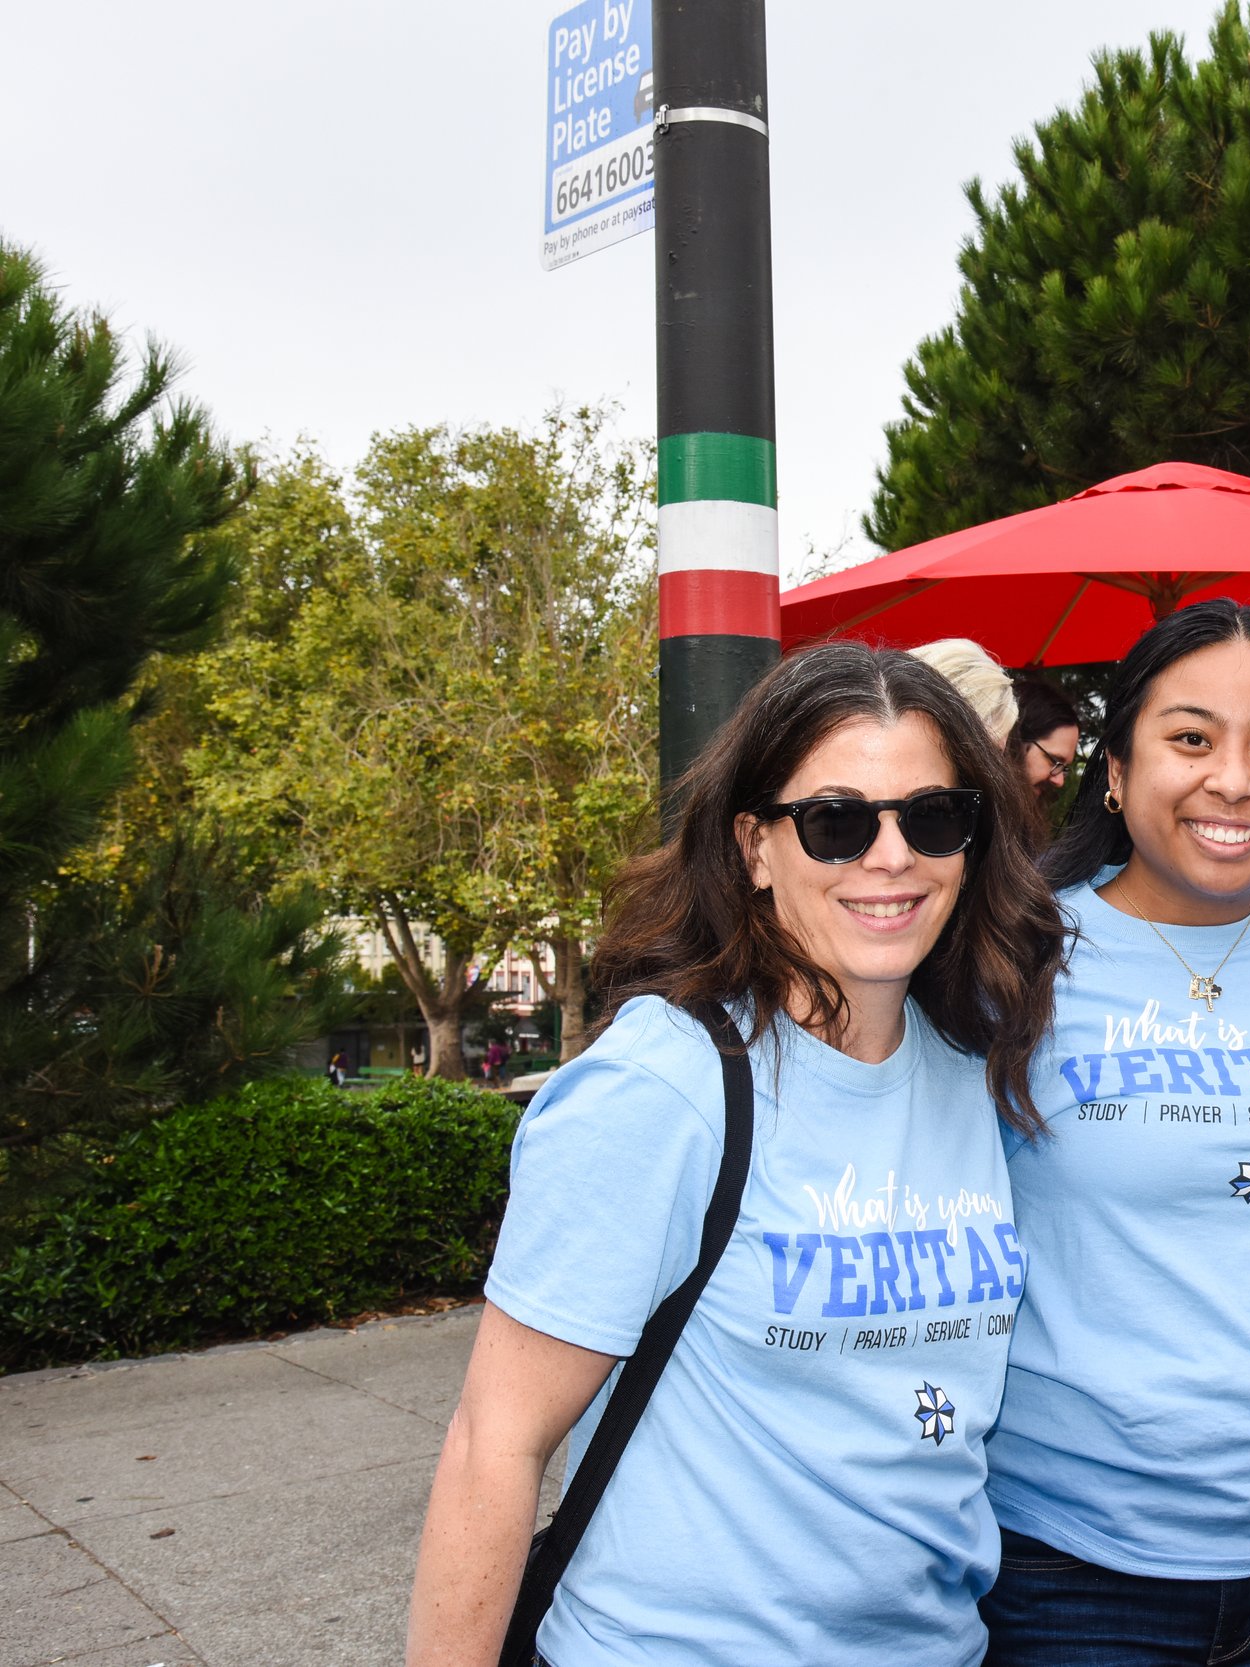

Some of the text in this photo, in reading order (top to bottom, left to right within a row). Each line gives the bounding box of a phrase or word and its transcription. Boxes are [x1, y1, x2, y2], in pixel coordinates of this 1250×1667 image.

[554, 0, 634, 68] Pay by
[553, 43, 641, 115] License
[551, 106, 611, 161] Plate
[556, 139, 655, 215] 66416003
[544, 240, 558, 256] Pay
[560, 233, 571, 250] by
[572, 222, 599, 247] phone
[600, 217, 610, 231] or
[611, 211, 621, 226] at
[1104, 999, 1207, 1051] What
[1218, 1018, 1248, 1051] is
[1077, 1103, 1128, 1121] STUDY
[1160, 1104, 1222, 1123] PRAYER
[803, 1163, 1002, 1248] What is your
[762, 1223, 1025, 1318] VERITAS
[765, 1325, 827, 1352] STUDY
[853, 1326, 907, 1351] PRAYER
[924, 1317, 972, 1343] SERVICE
